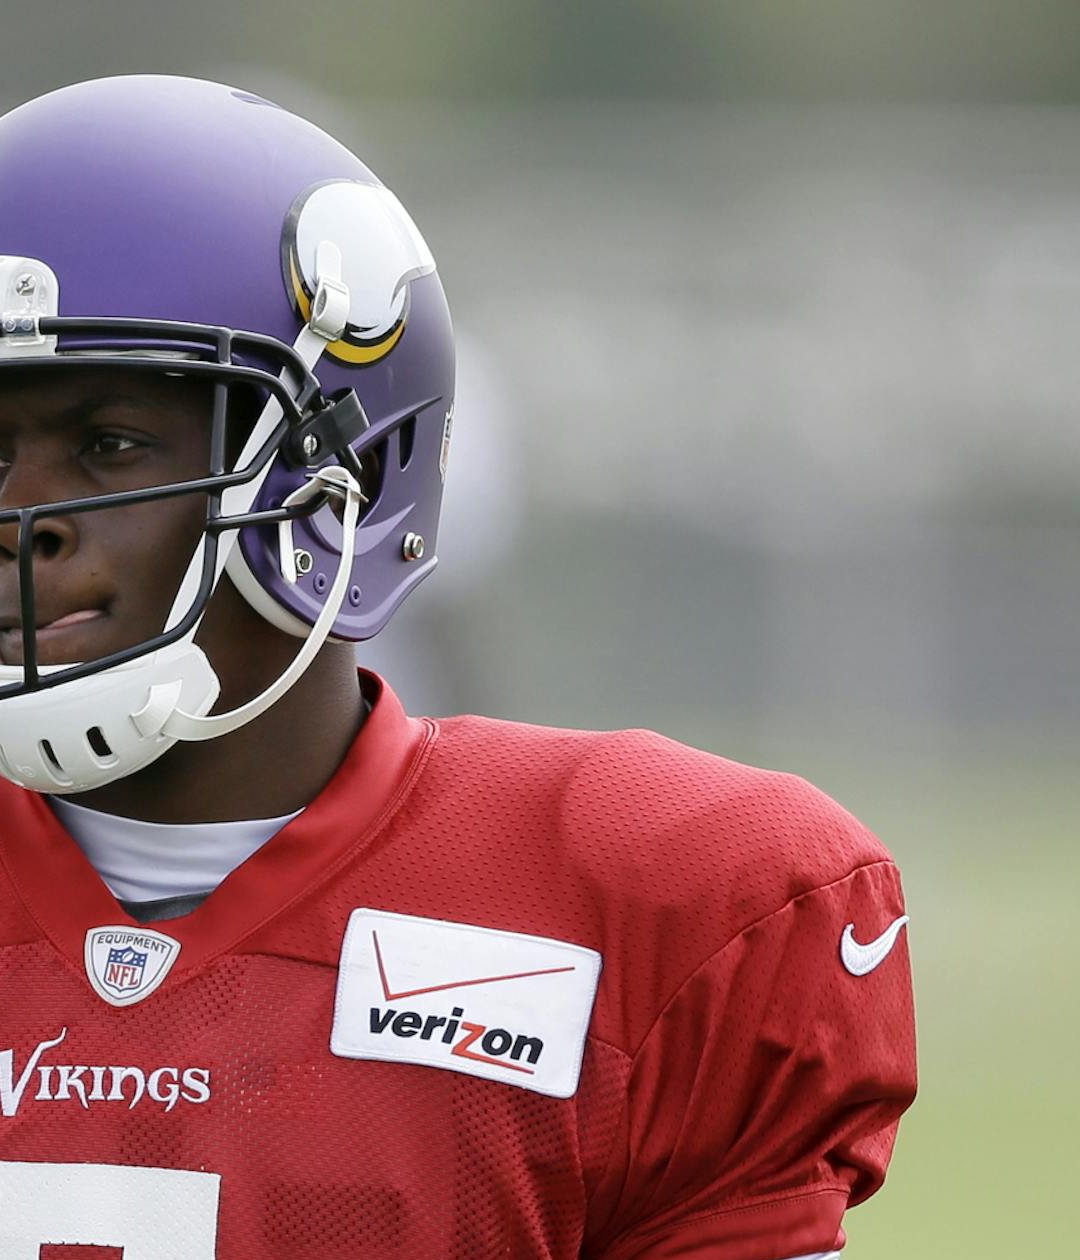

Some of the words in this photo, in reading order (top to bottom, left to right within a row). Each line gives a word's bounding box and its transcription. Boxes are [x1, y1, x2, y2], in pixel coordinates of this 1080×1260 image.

[97, 934, 167, 954] EQUIPMENT
[107, 963, 139, 987] NFL
[369, 1006, 545, 1075] verizon
